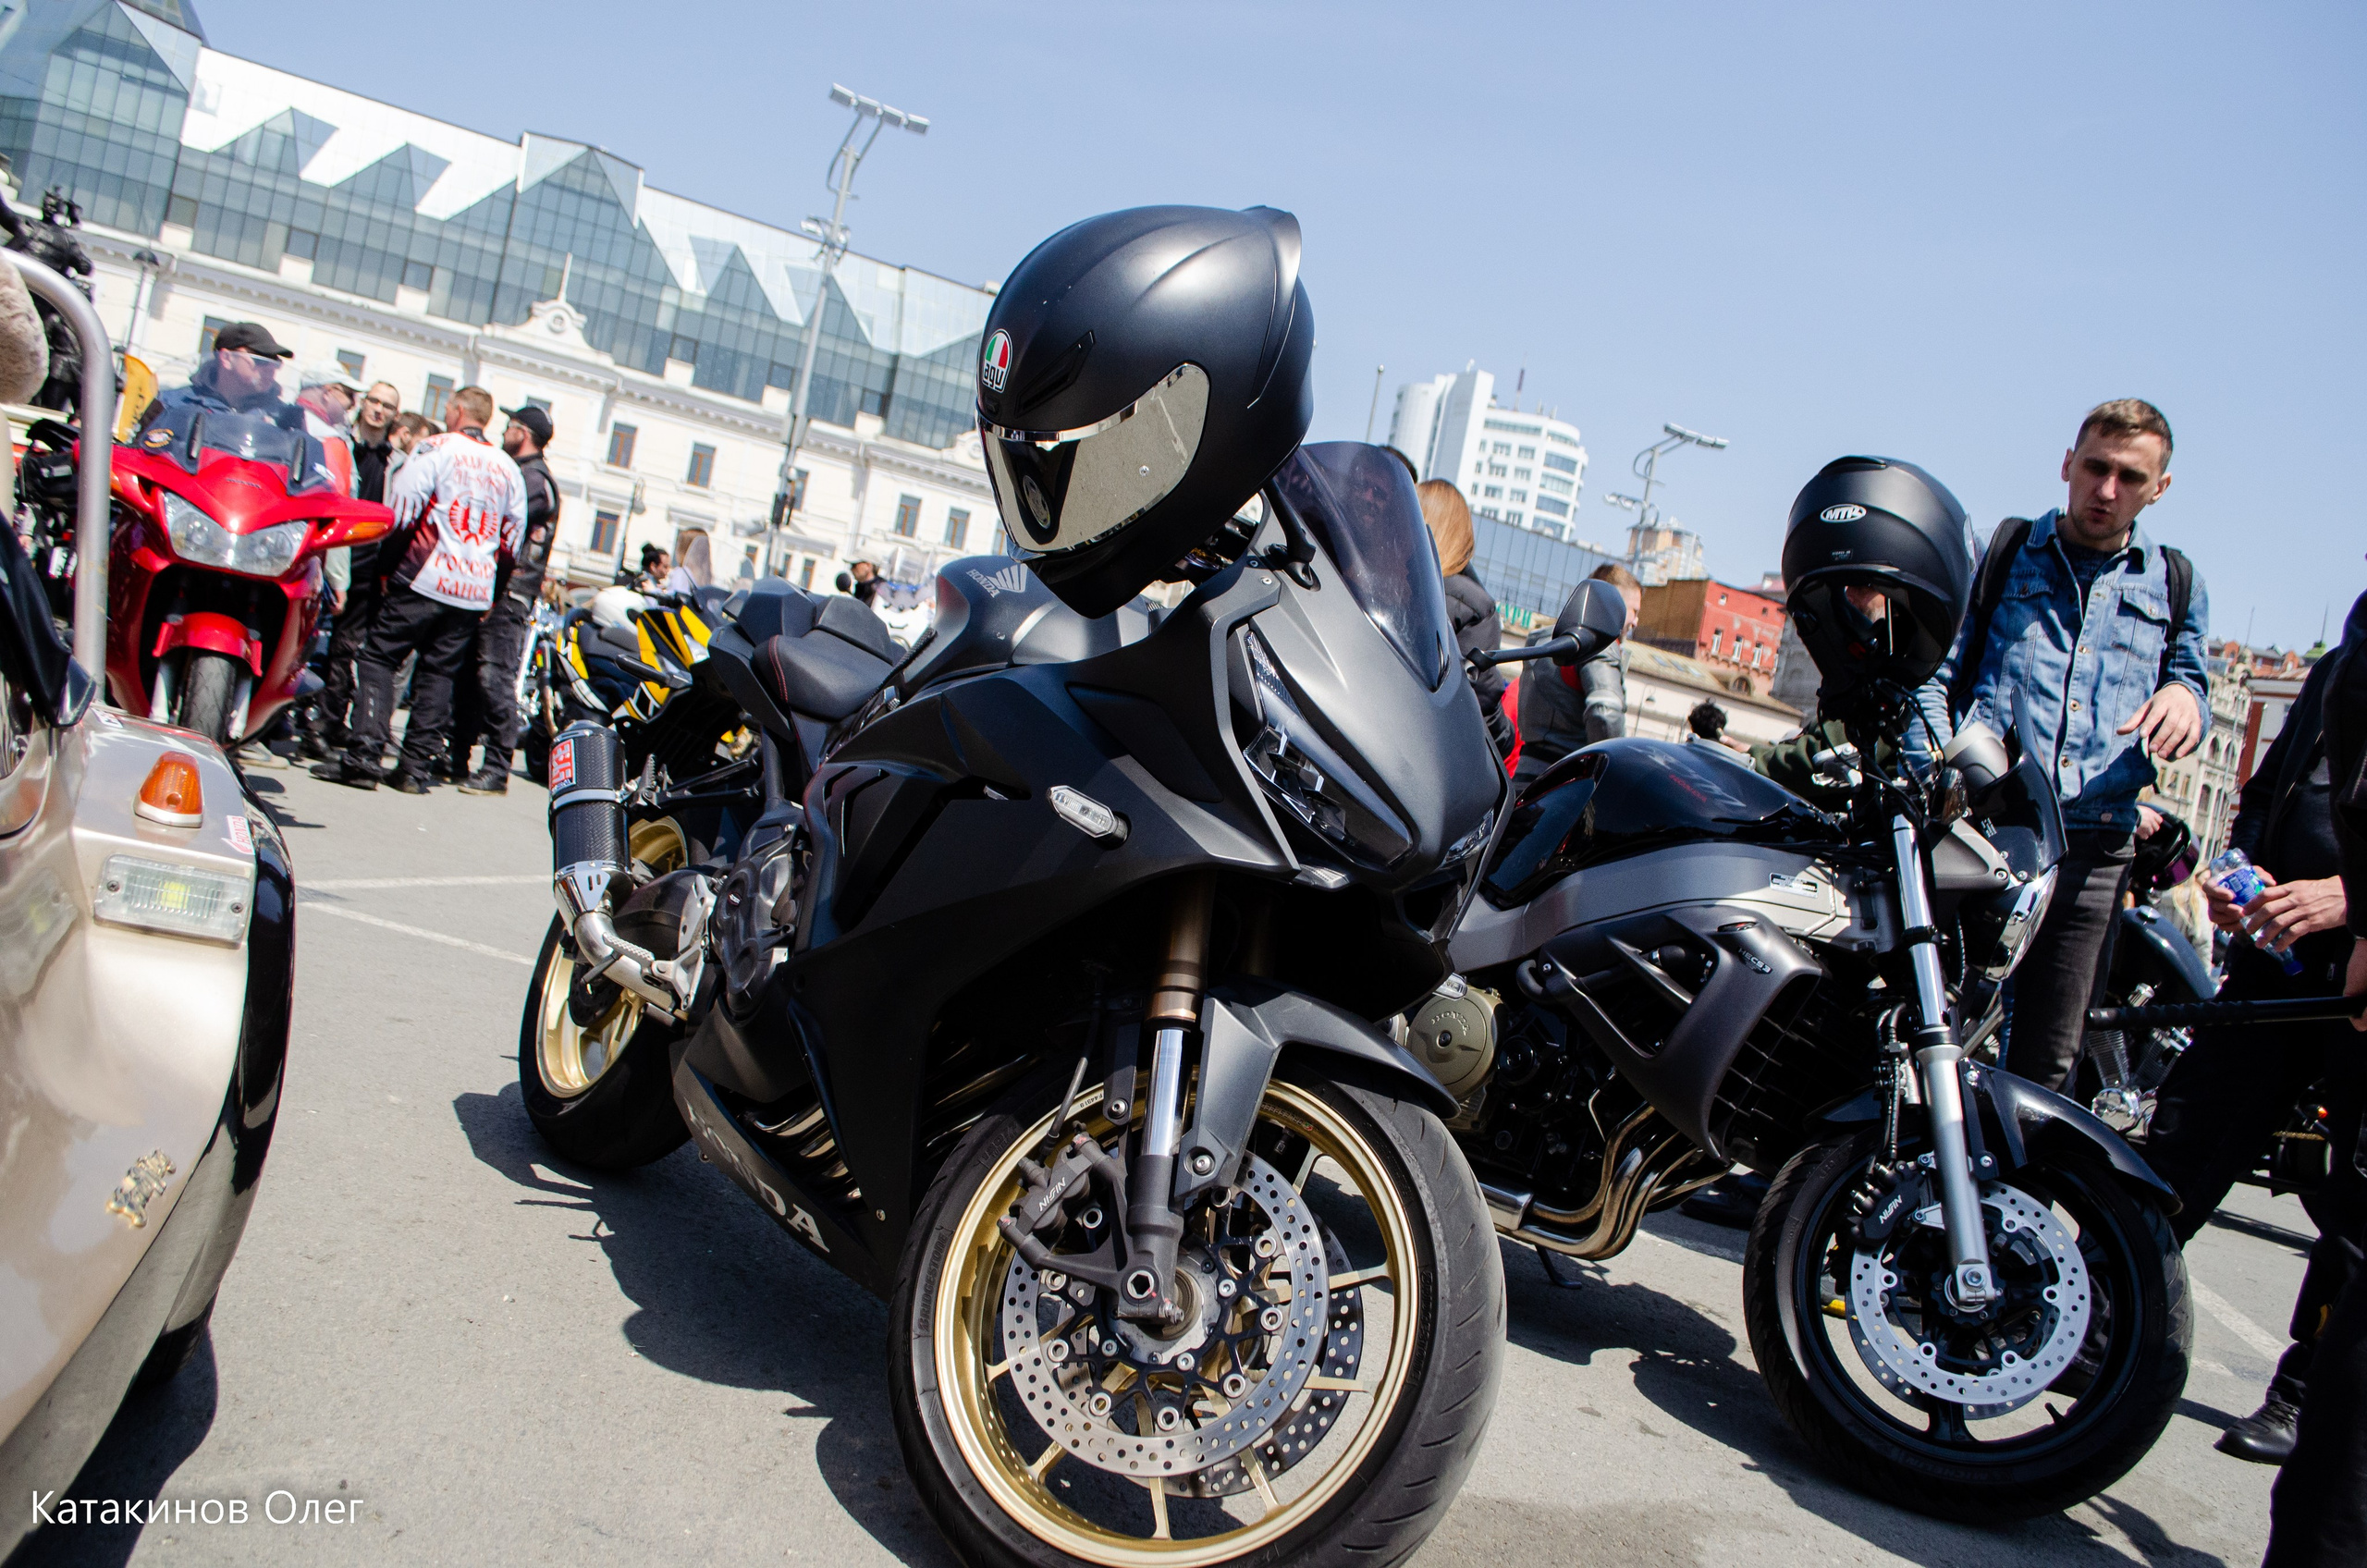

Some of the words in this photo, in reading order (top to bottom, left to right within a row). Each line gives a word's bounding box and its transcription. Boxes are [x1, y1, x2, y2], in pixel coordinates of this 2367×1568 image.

[966, 569, 1000, 598] HONDA
[232, 816, 251, 845] HONDA
[683, 1097, 830, 1254] HONDA
[917, 1231, 947, 1331] BRIDGESTONE
